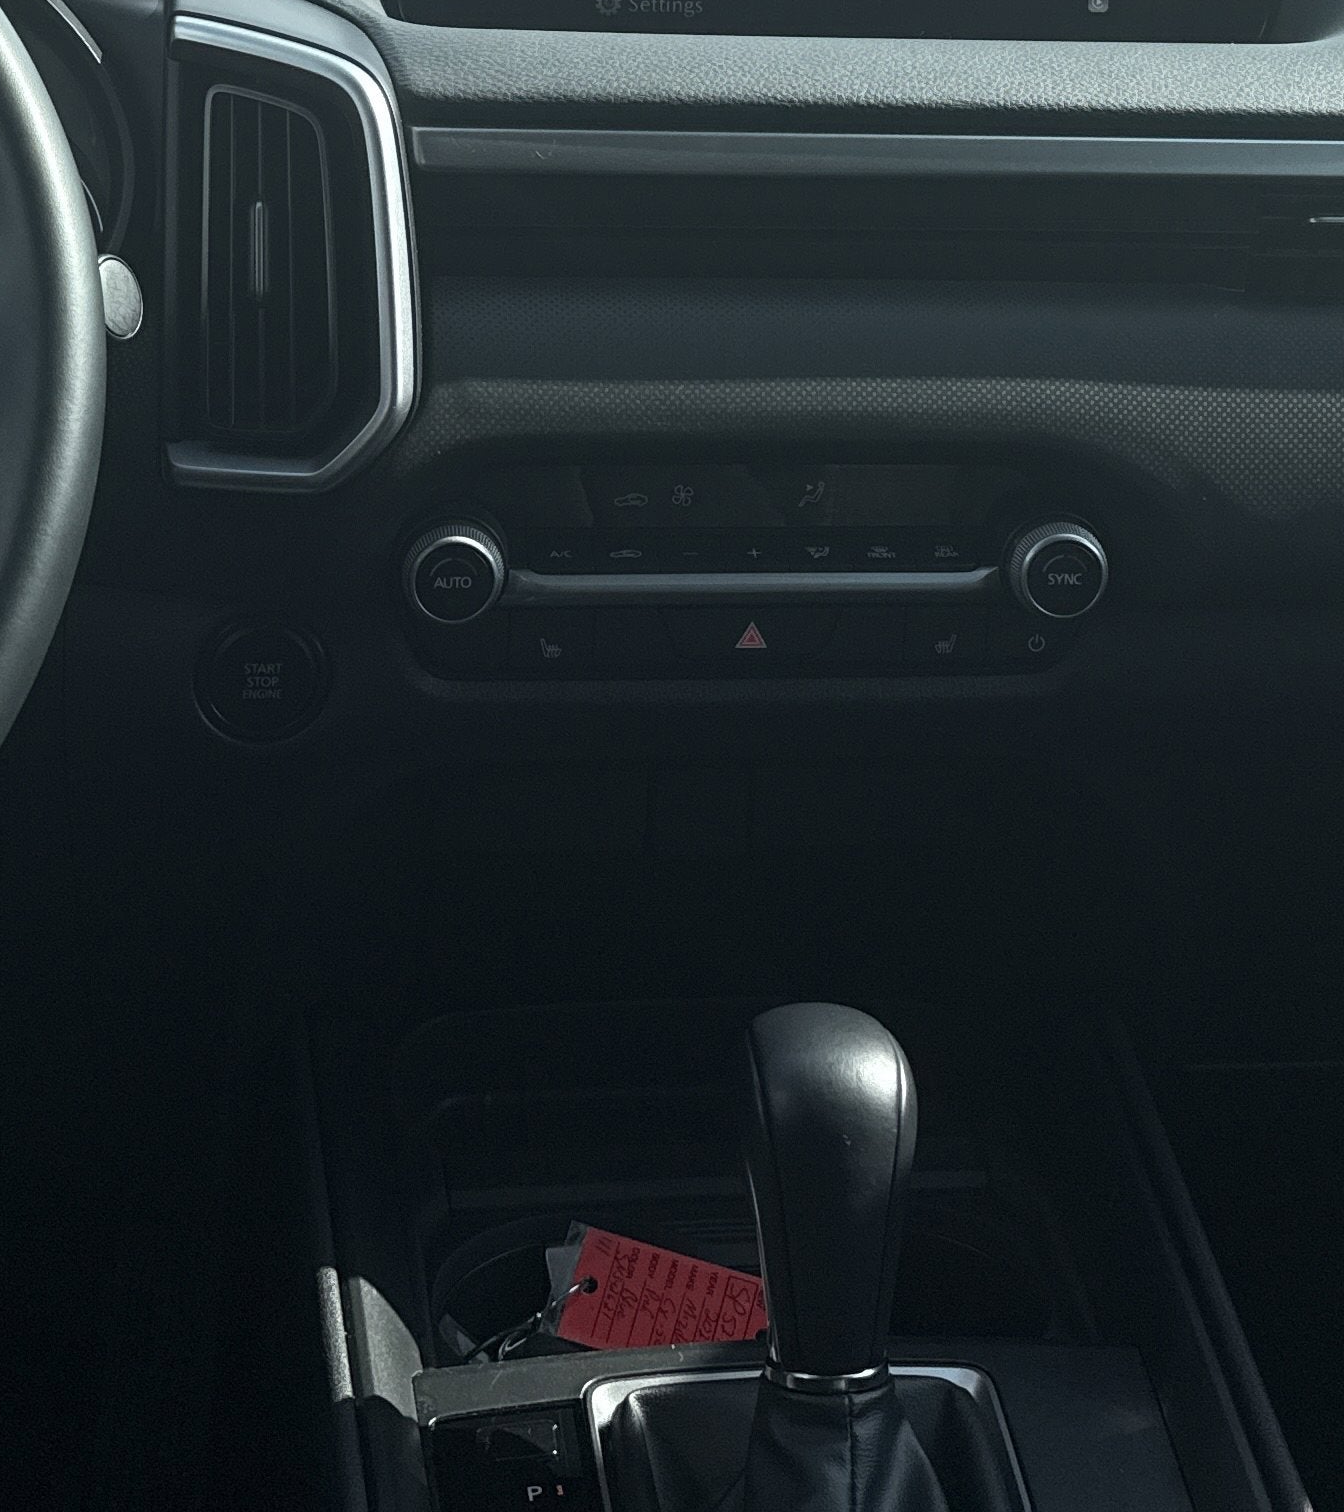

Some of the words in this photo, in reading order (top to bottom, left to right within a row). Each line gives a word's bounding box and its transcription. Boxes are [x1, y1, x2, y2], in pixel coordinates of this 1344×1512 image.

[549, 549, 574, 558] A/C
[433, 576, 473, 589] AUTO
[1047, 572, 1083, 586] SYNC
[242, 662, 284, 675] START
[246, 676, 280, 688] STOP
[241, 688, 284, 700] ENGINE
[625, 1247, 641, 1280] COLOR
[645, 1252, 661, 1279] BODY
[663, 1259, 680, 1292] MODEL
[685, 1264, 700, 1291] MAKE
[704, 1270, 720, 1297] YEAR
[526, 1485, 543, 1502] P
